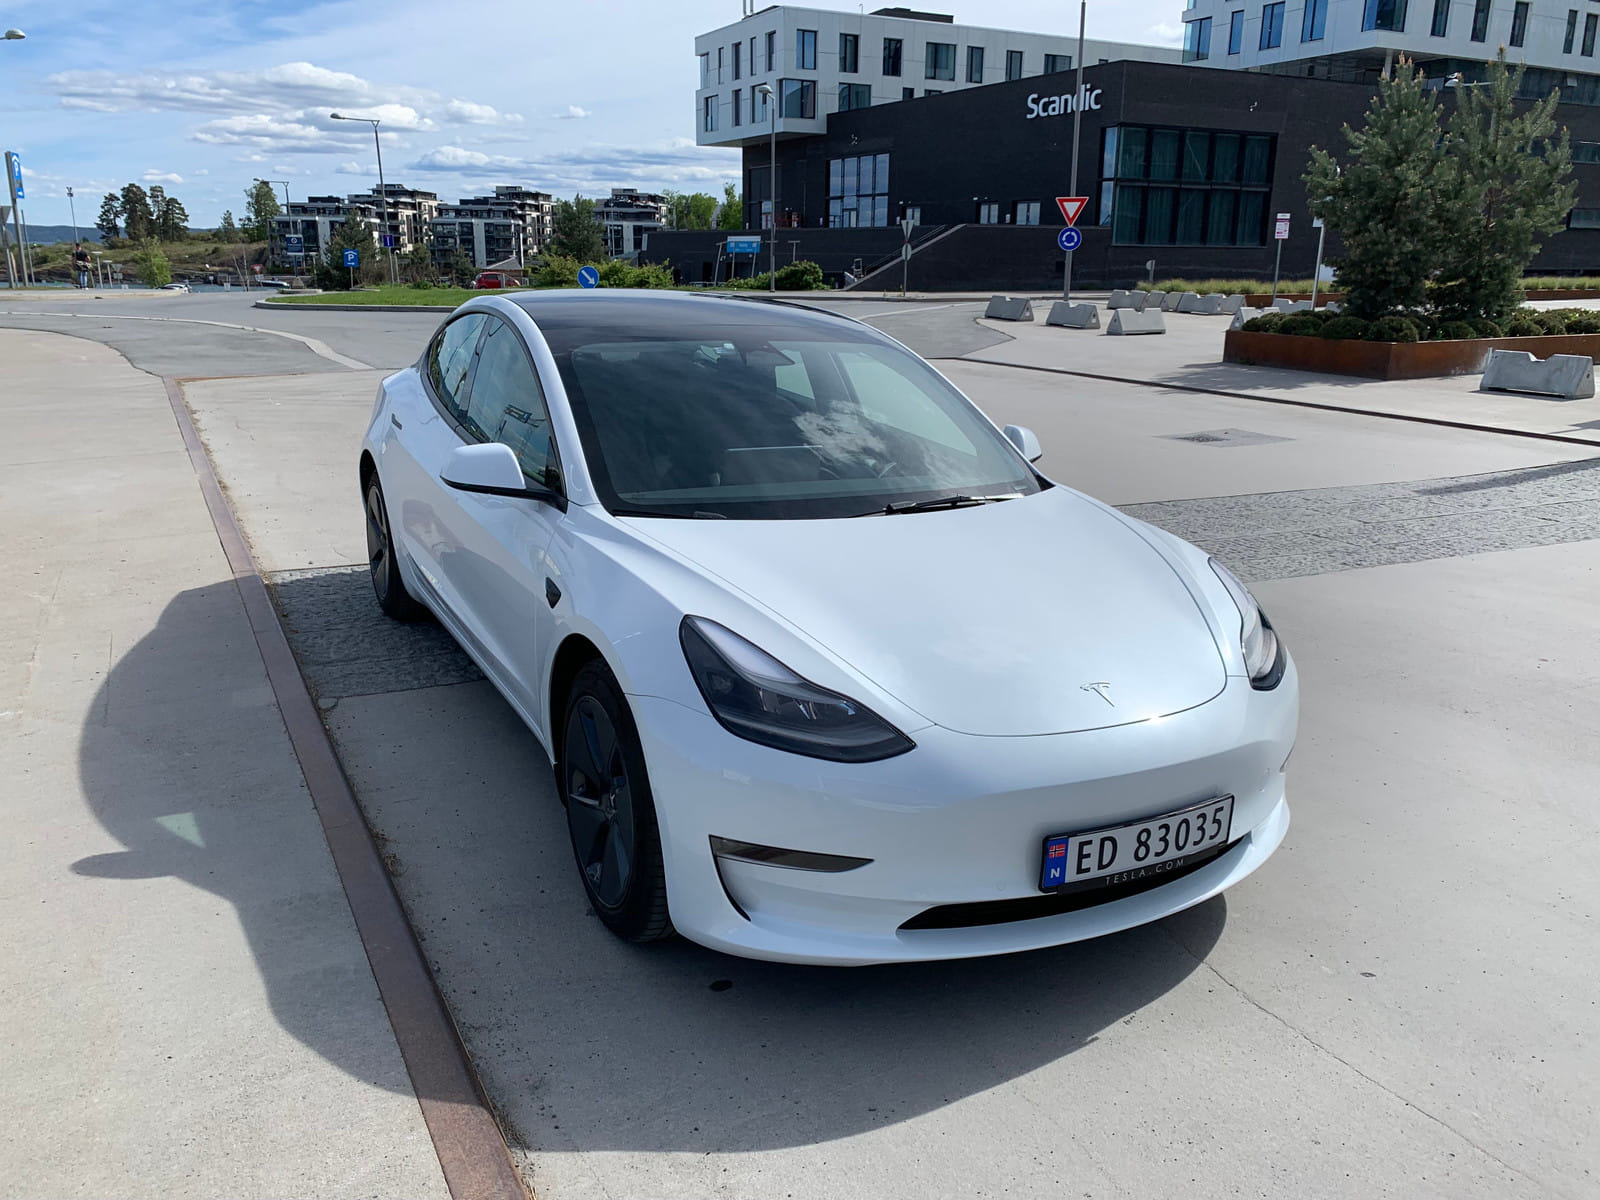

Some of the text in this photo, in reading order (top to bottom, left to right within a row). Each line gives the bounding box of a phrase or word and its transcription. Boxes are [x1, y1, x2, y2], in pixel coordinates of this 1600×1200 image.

[1026, 83, 1102, 119] Scandic
[1076, 806, 1225, 875] ED 83035
[1050, 867, 1060, 879] N
[1105, 858, 1184, 886] TESLA.COM
